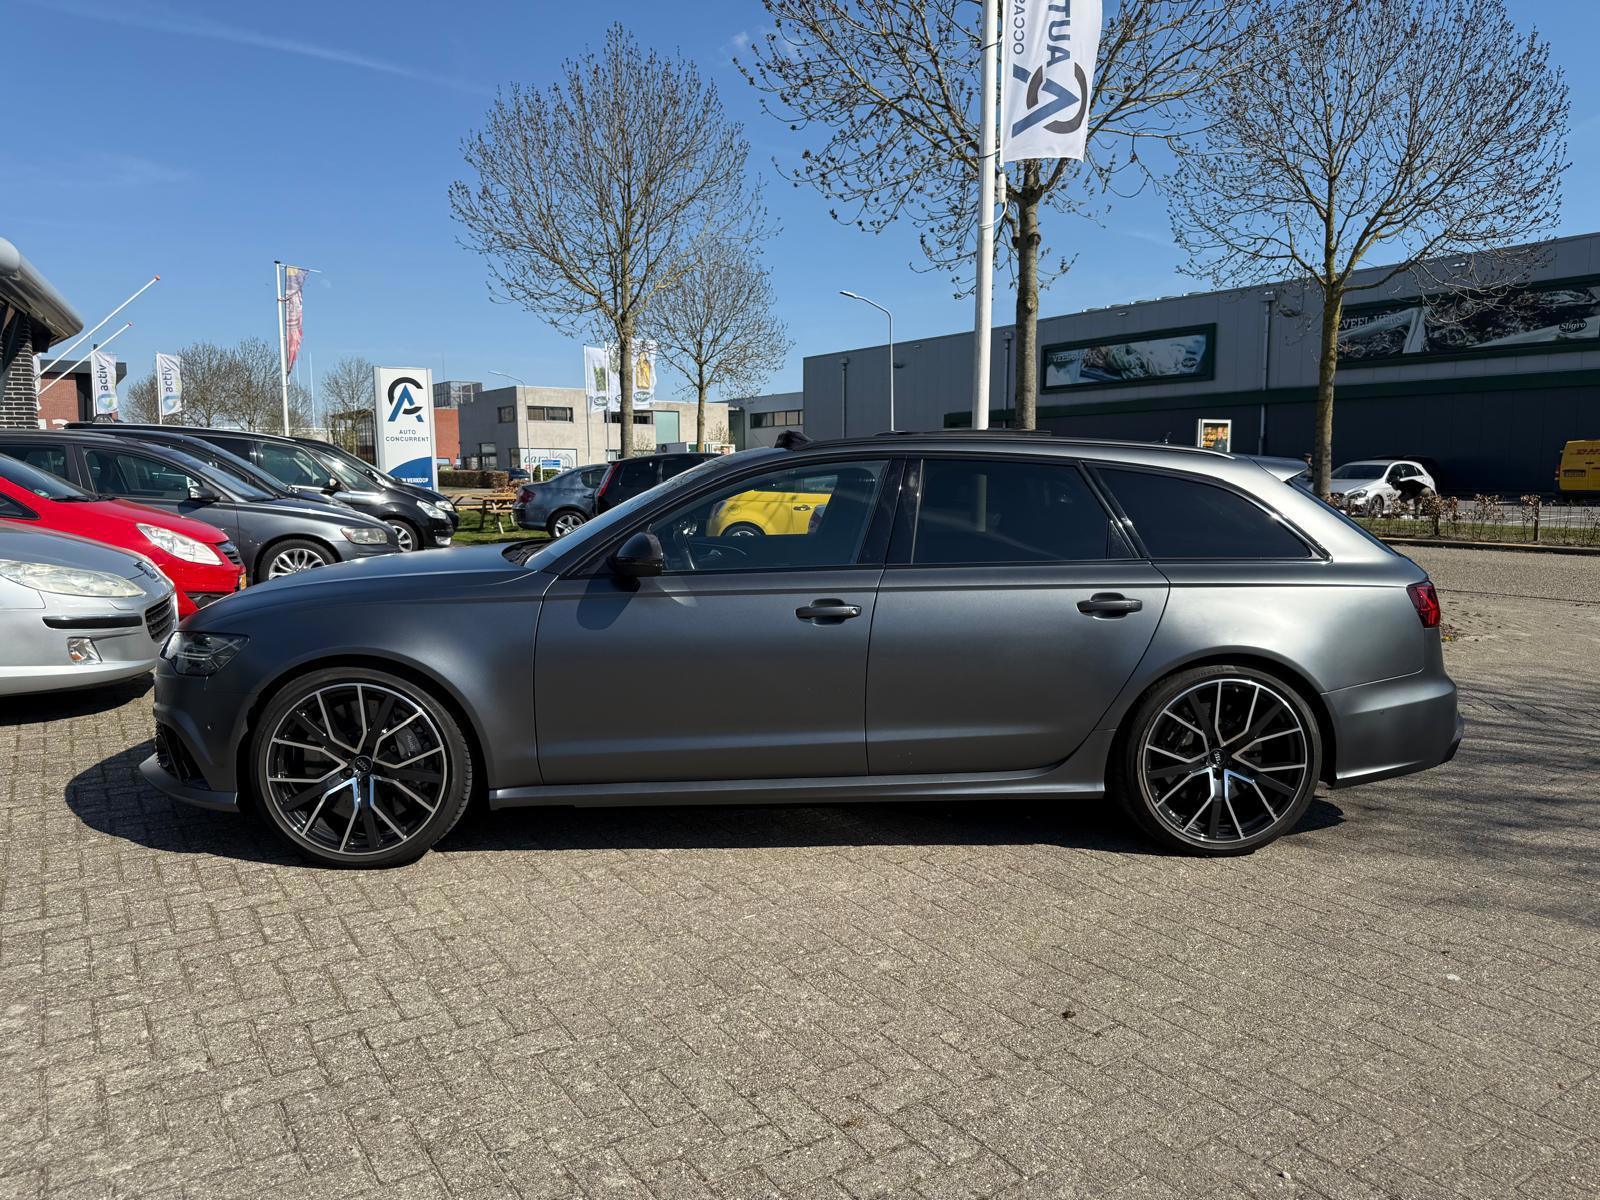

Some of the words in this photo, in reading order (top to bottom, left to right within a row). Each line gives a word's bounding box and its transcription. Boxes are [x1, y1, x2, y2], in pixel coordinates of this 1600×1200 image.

[1560, 319, 1586, 333] Sligro
[97, 364, 108, 391] activ
[162, 366, 173, 393] activ
